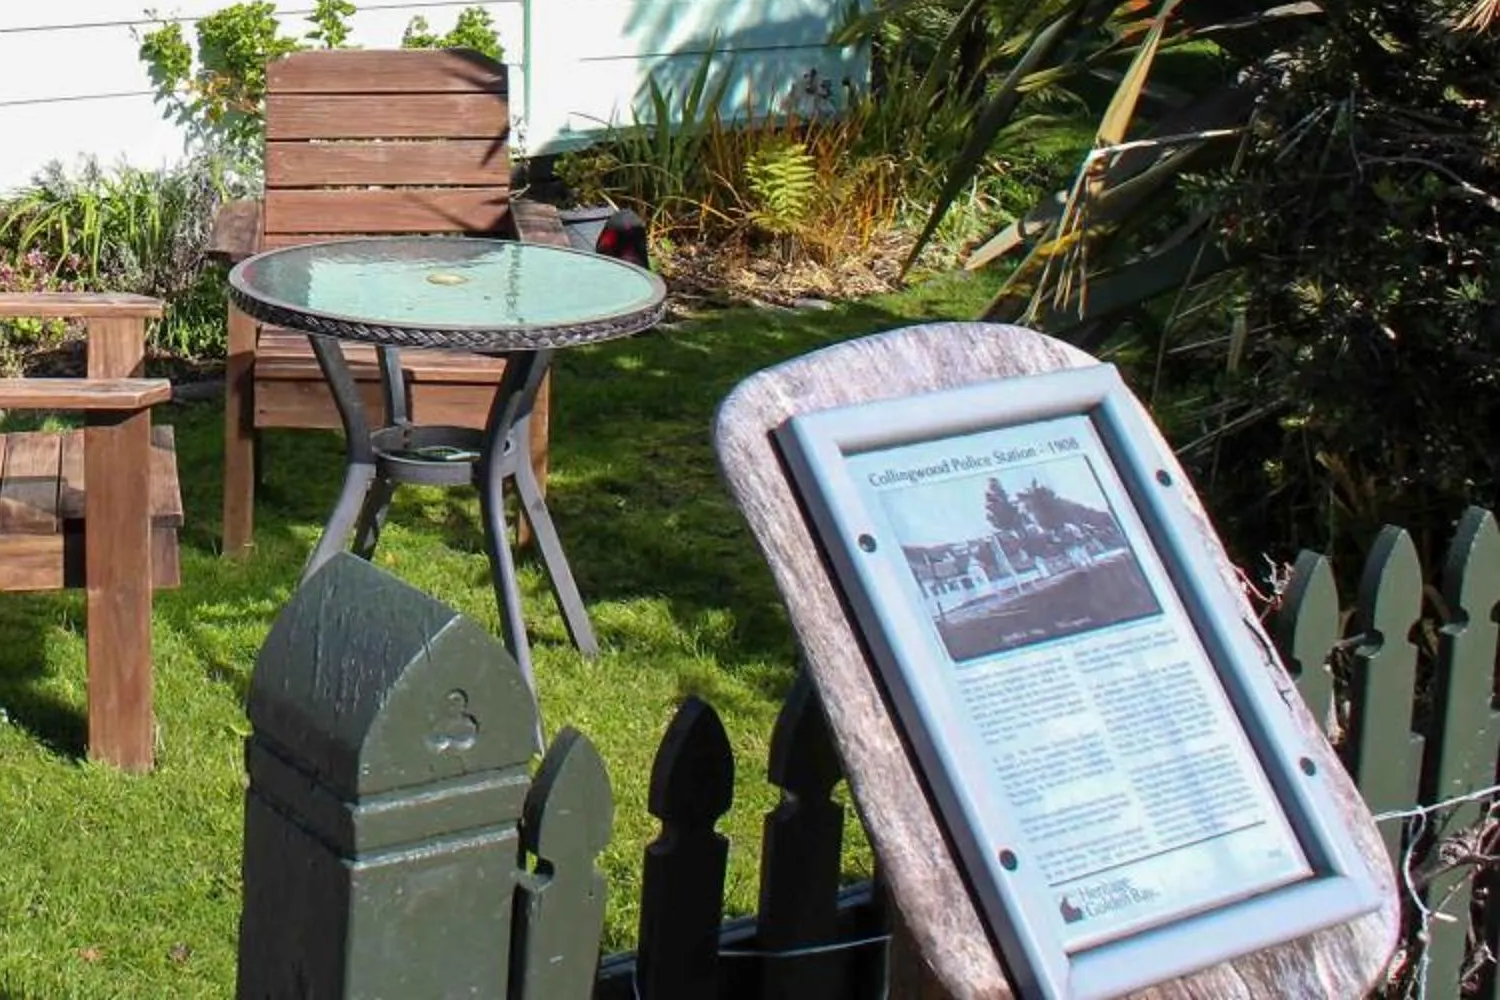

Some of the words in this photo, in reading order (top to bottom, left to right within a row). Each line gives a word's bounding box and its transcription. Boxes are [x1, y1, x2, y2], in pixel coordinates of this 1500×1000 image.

[868, 458, 951, 487] Collingwood
[950, 455, 993, 472] Police
[993, 445, 1036, 465] Station
